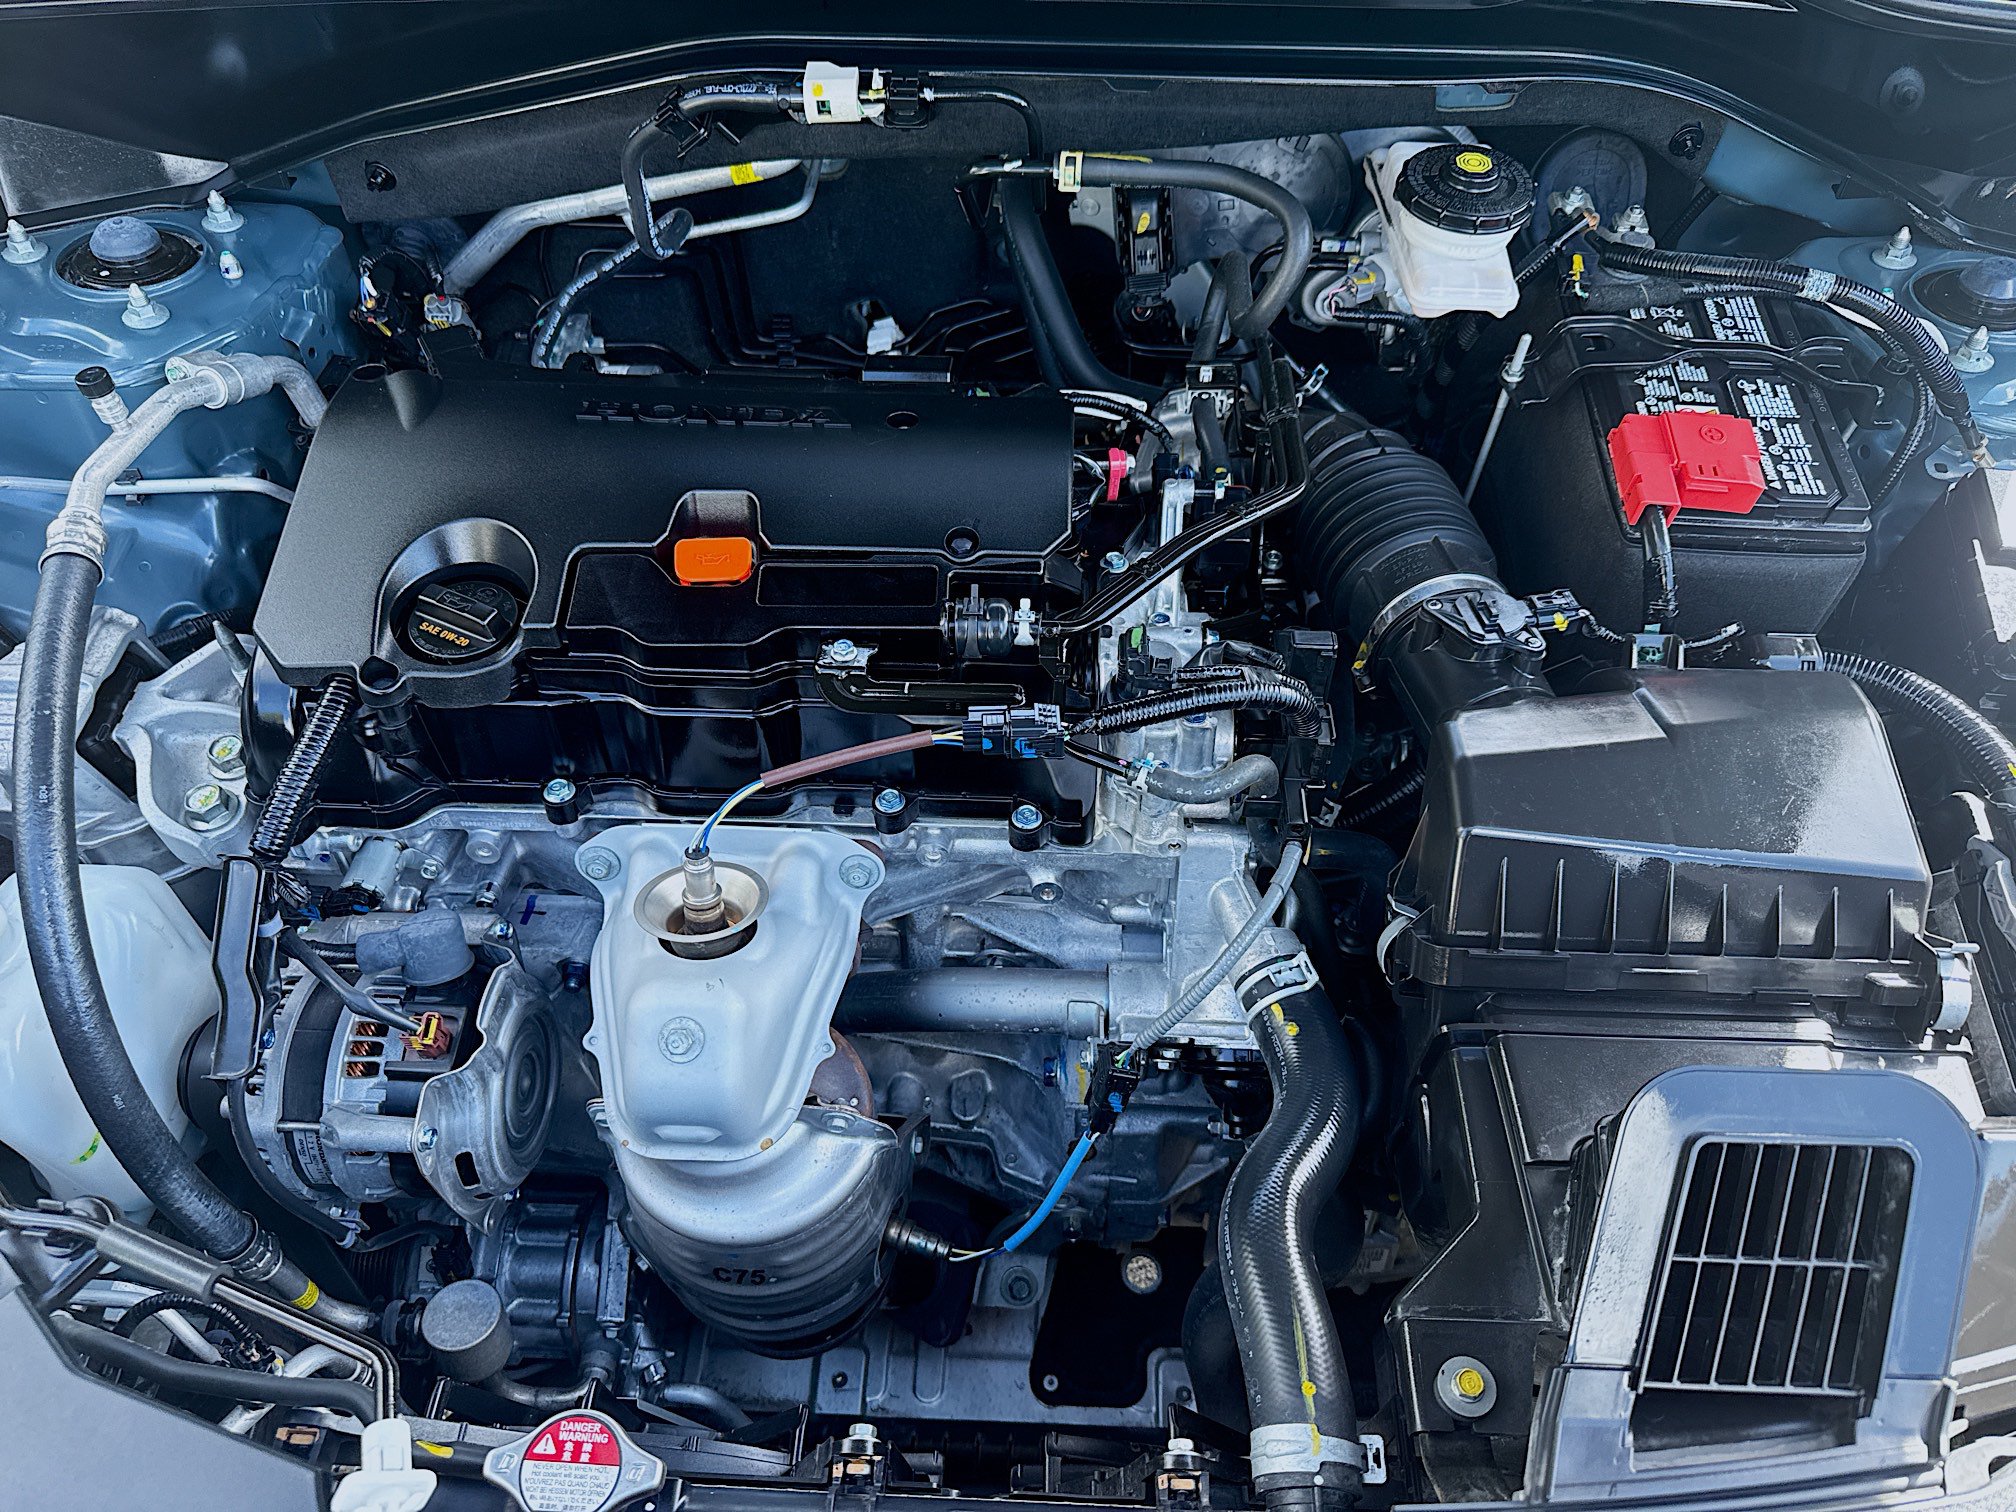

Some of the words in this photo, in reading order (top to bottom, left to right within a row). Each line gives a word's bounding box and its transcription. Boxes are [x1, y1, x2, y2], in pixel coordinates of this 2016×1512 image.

[576, 401, 852, 428] HONDA
[419, 621, 442, 636] SAE
[439, 630, 470, 647] 0W-20
[1176, 787, 1193, 796] 24
[712, 1266, 766, 1286] C75
[560, 1420, 602, 1433] DANGER
[558, 1431, 609, 1444] WARNUNG
